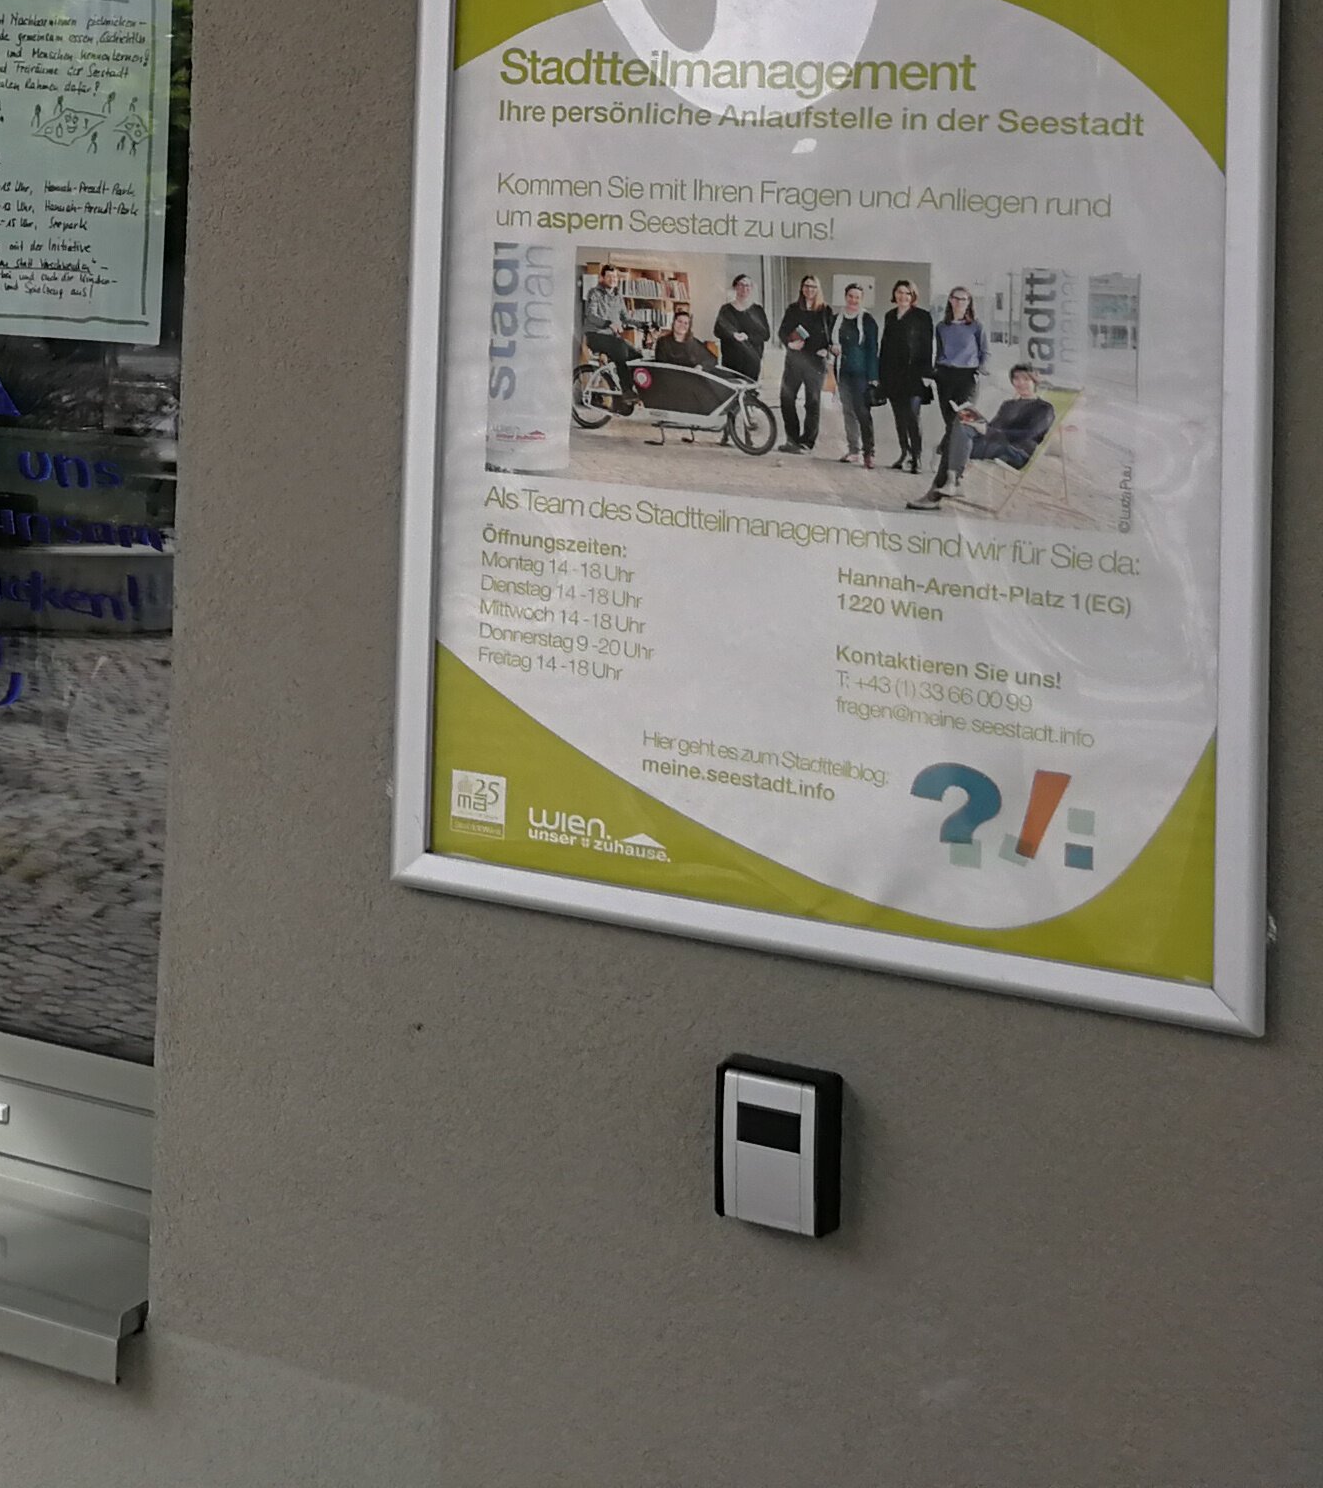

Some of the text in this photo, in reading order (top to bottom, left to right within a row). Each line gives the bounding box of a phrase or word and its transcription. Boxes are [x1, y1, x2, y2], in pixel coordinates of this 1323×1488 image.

[500, 47, 976, 100] Stadtteilmanagement
[499, 99, 1144, 136] Ihre persönliche Anlaufstelle in der Seestadt
[497, 172, 1111, 218] Kommen Sie mit Ihren Fragen und Anliegen rund
[496, 209, 834, 241] um aspern Seestadt zu uns!
[19, 450, 123, 489] uns
[482, 523, 627, 558] Öffnungszeiten:
[484, 486, 1140, 577] Als Team des Stadtteilmanagements sind wir für Sie da:
[481, 550, 544, 577] Montag
[549, 559, 568, 574] 14
[604, 564, 635, 583] Uhr
[481, 574, 551, 601] Dienstag
[556, 584, 575, 600] 14
[612, 590, 643, 609] Uhr
[838, 567, 1064, 609] Hannah-Arendt-Platz
[480, 599, 554, 622] Mittwoch
[560, 610, 579, 625] 14
[615, 616, 646, 634] Uhr
[836, 594, 943, 622] 1220 Wien
[479, 622, 573, 653] Donnerstag
[576, 635, 589, 652] 9
[623, 641, 655, 660] Uhr
[478, 646, 532, 672] Freitag
[537, 655, 556, 672] 14
[592, 662, 623, 681] Uhr
[836, 645, 1061, 689] Kontaktieren Sie uns!
[836, 670, 850, 689] T:
[856, 675, 891, 694] +43
[836, 696, 1095, 749] fragen@meine.seestadt.info
[642, 729, 889, 785] Hier geht es zum Stadtteilblog:
[642, 759, 835, 801] meine.seestadt.info
[528, 828, 672, 863] unser zuhause.
